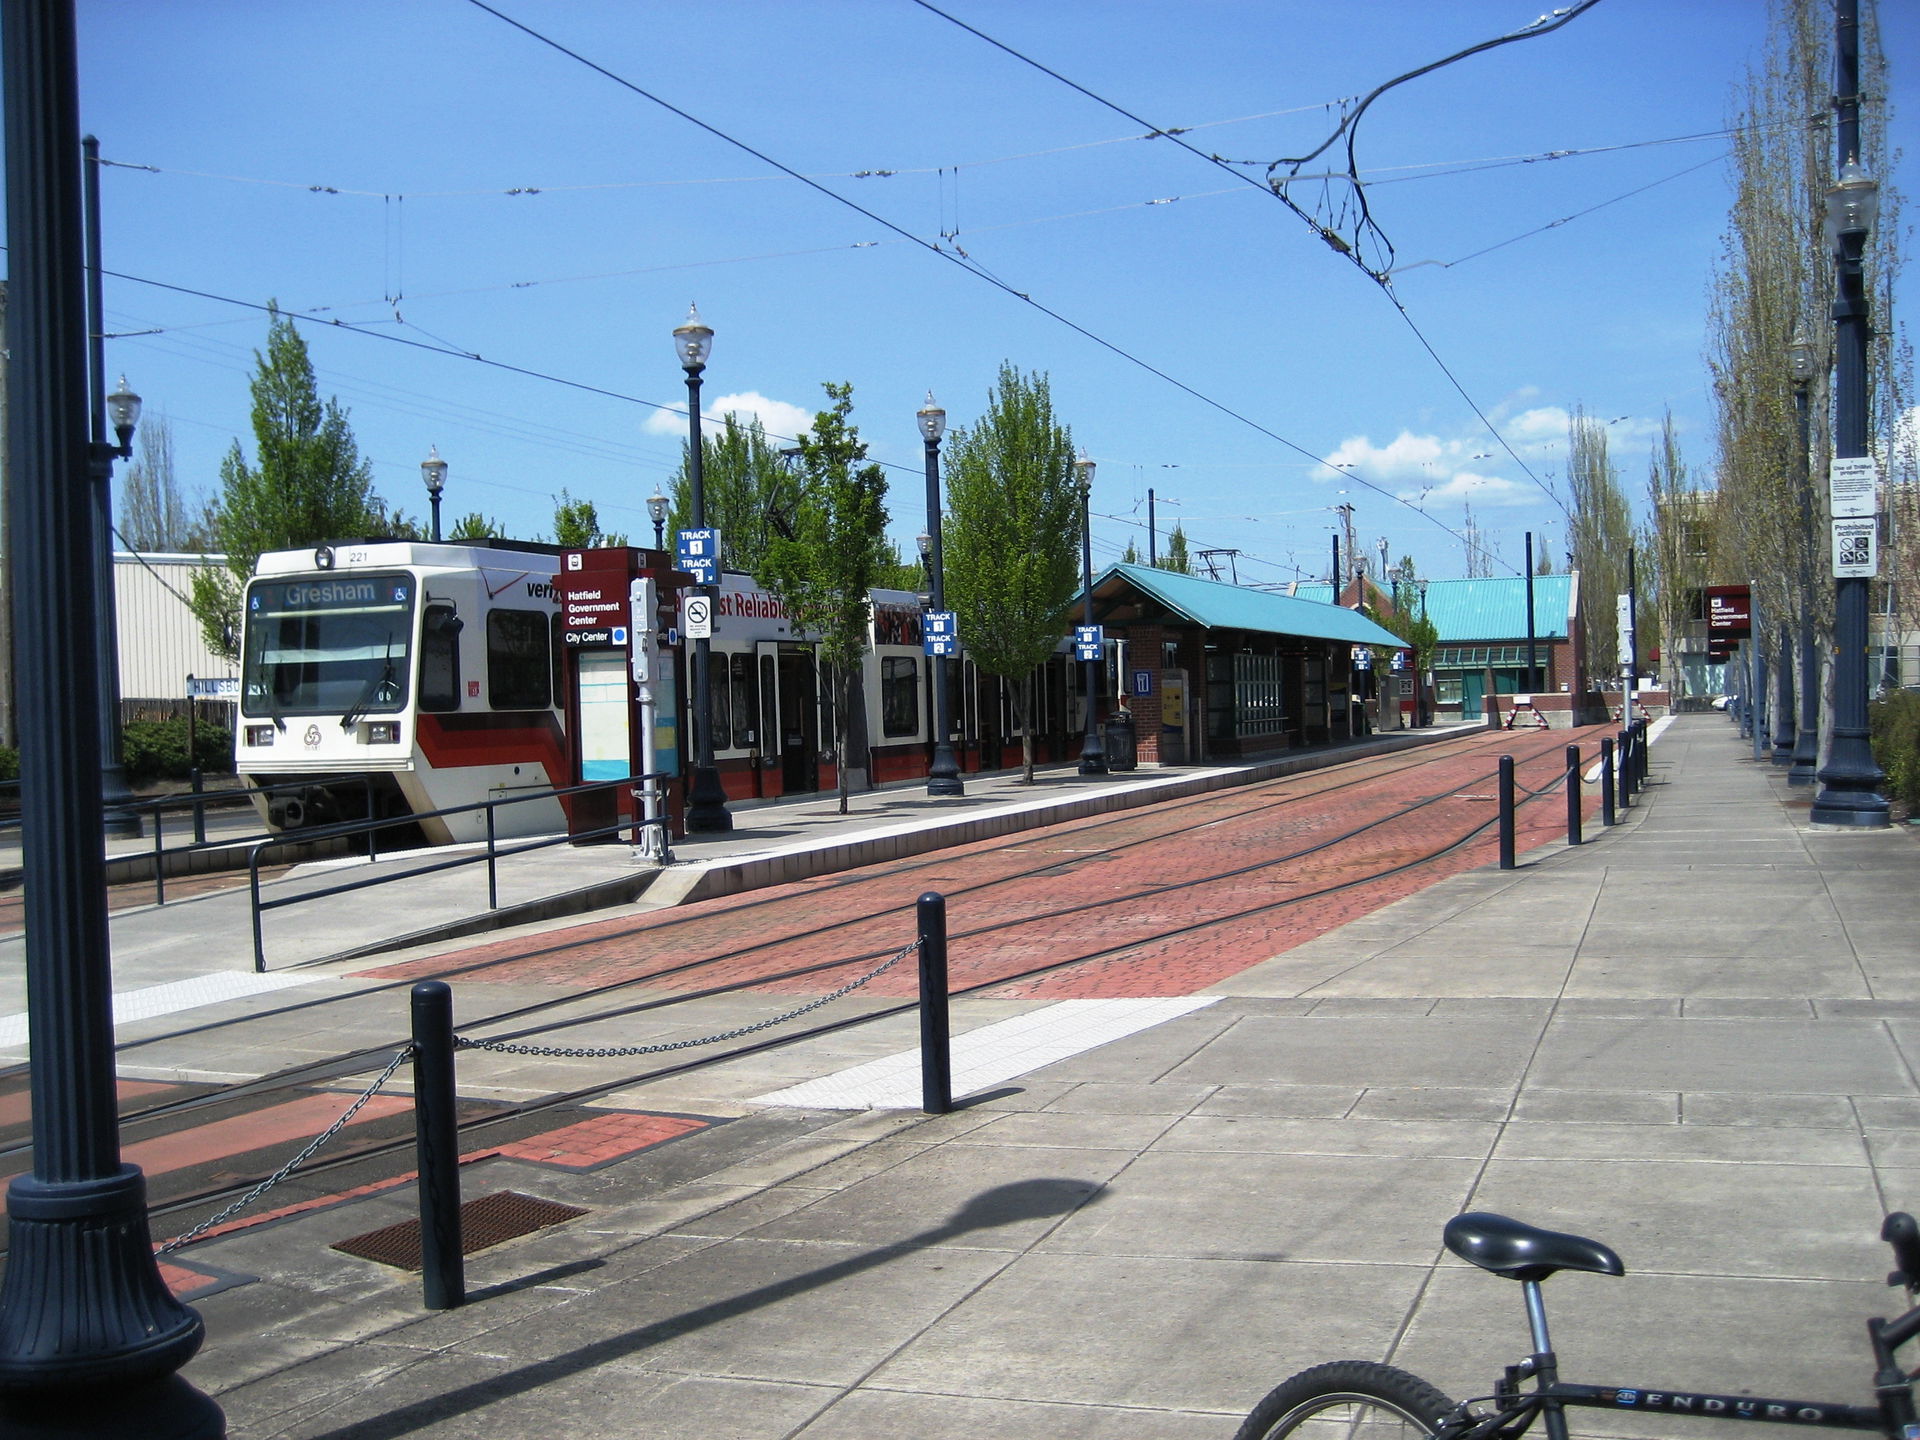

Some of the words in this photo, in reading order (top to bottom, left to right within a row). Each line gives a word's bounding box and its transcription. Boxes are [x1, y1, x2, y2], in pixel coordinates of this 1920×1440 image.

[680, 530, 712, 541] TRACK
[350, 552, 368, 562] 221
[681, 558, 712, 569] TRACK
[285, 582, 376, 605] Gresham
[568, 590, 601, 601] Hatfield
[568, 602, 620, 613] Government
[568, 616, 598, 626] Center
[926, 613, 951, 621] TRACK
[565, 633, 581, 644] City
[582, 632, 608, 643] Center
[1645, 1393, 1823, 1421] ENDURO
